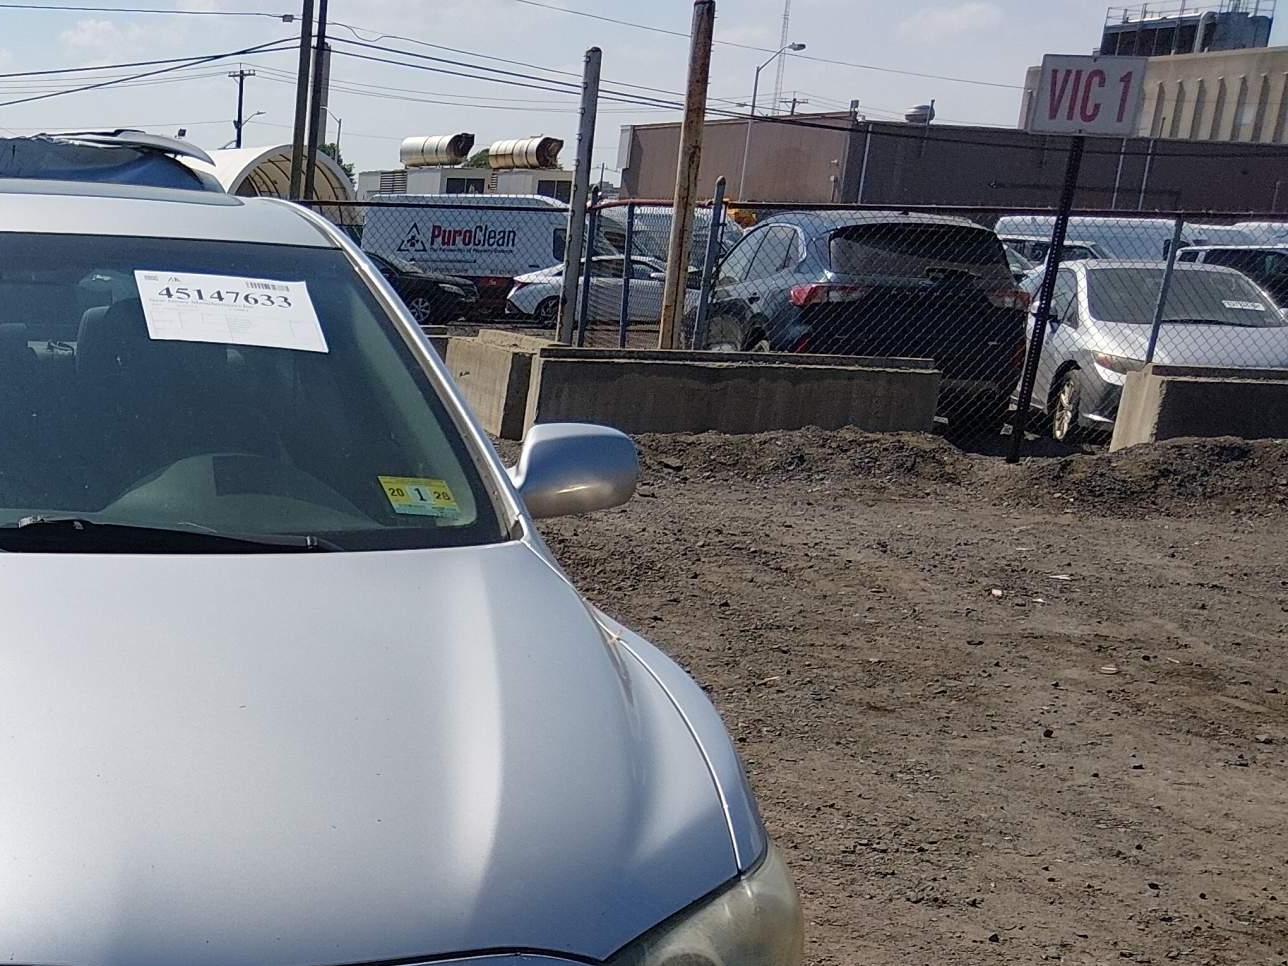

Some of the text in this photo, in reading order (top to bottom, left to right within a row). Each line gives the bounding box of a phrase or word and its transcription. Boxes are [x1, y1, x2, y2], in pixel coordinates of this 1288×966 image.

[1048, 68, 1133, 122] VIC 1
[430, 224, 517, 247] PuroClean
[158, 287, 292, 309] 45147633
[388, 487, 405, 497] 20
[413, 487, 427, 501] 1
